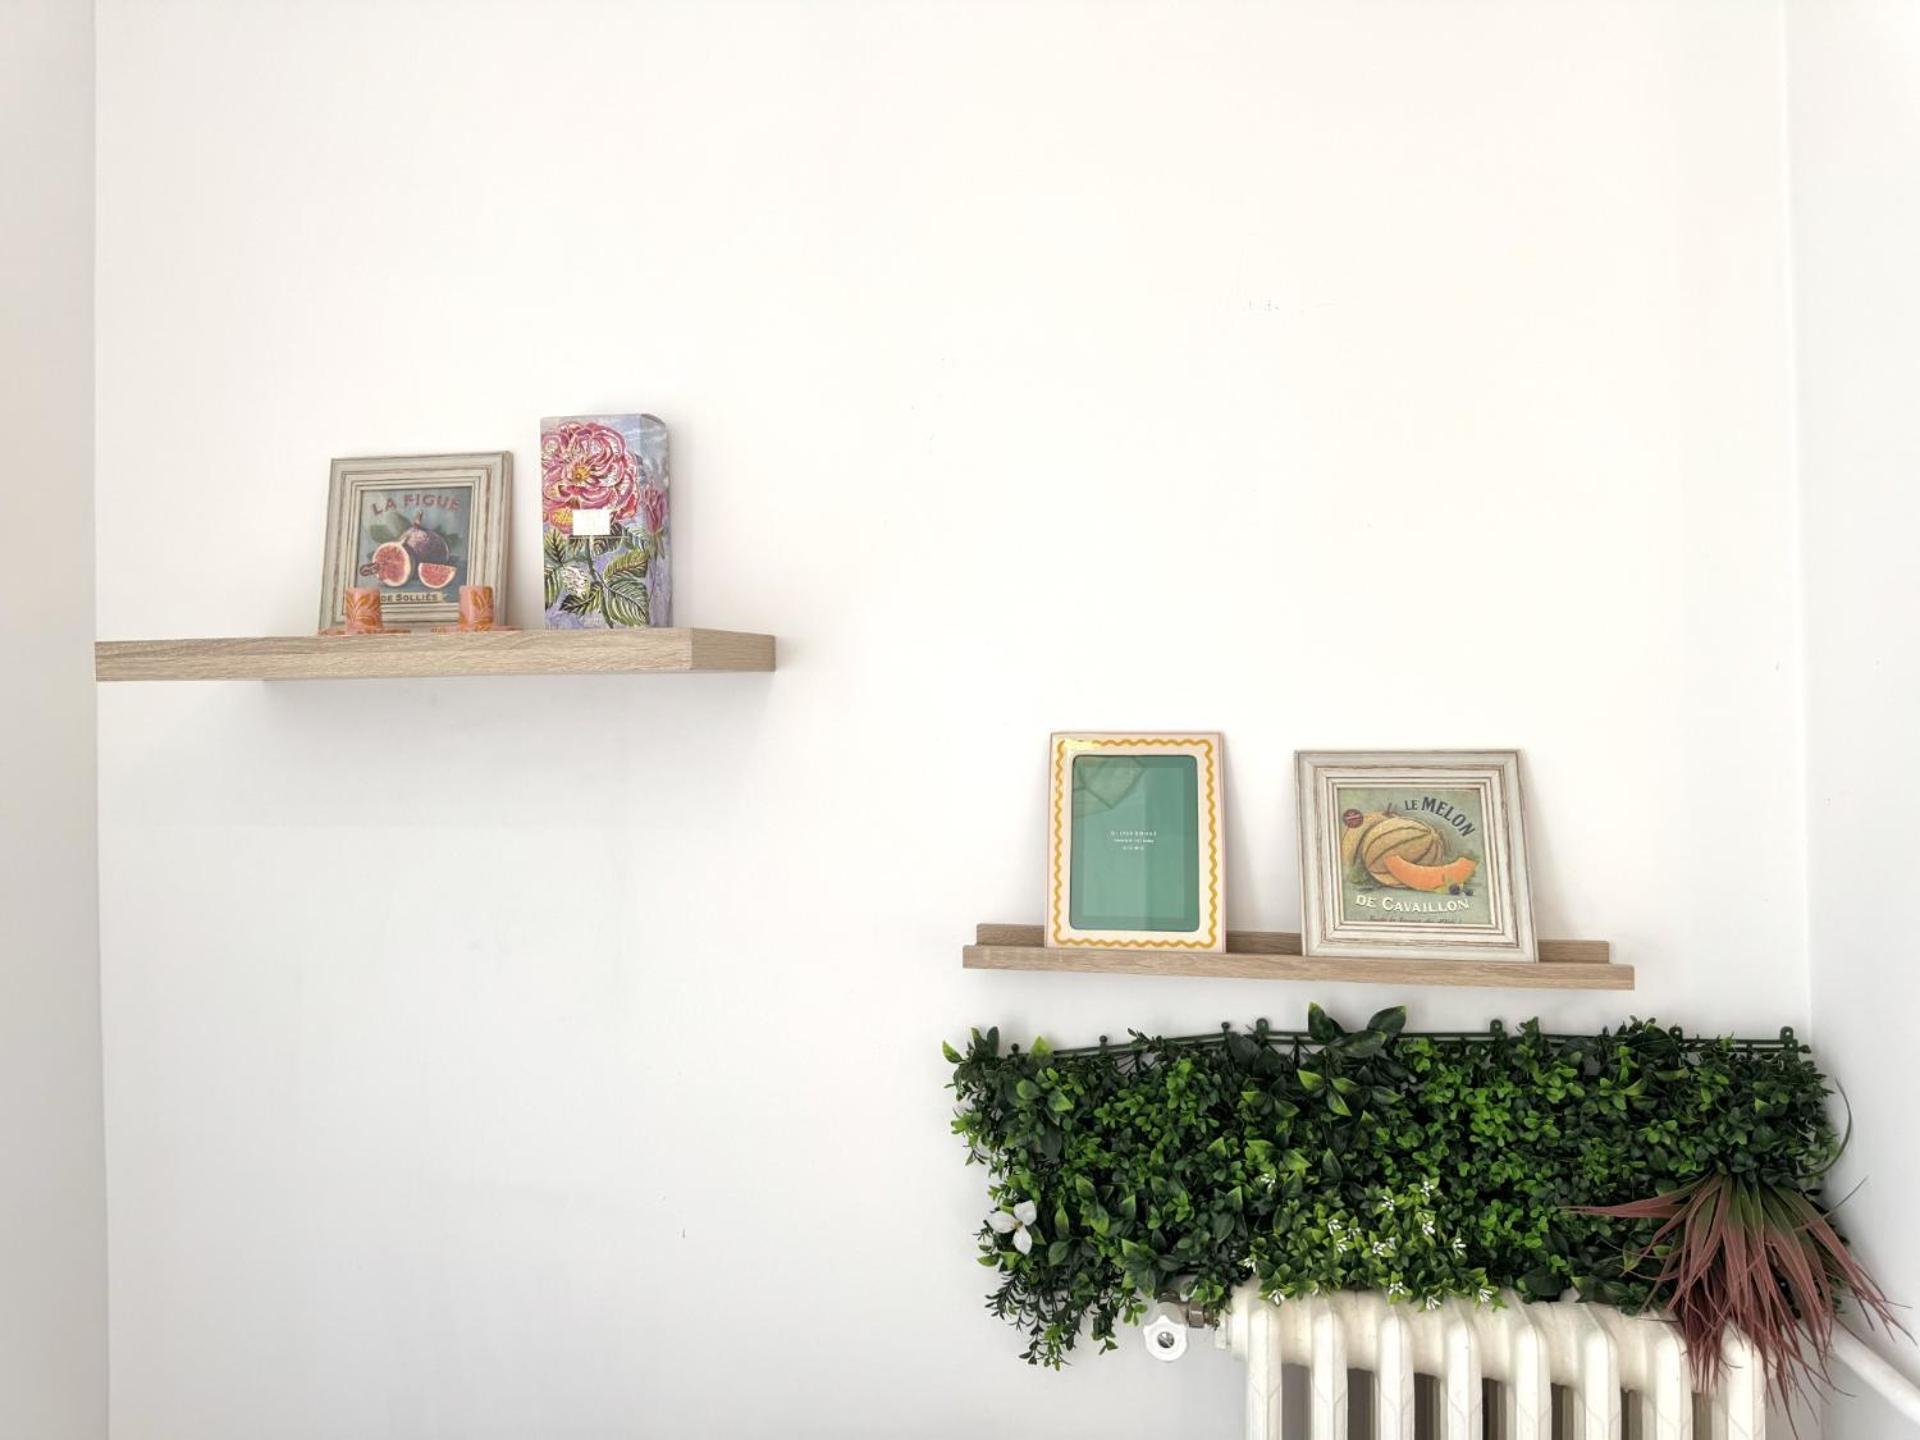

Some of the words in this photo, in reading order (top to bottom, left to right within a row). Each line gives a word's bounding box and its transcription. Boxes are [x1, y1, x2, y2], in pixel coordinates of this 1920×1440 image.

[372, 497, 398, 516] LA
[403, 493, 461, 513] FIGUE
[1404, 799, 1418, 811] LE
[1421, 796, 1476, 837] MELON
[1355, 894, 1377, 908] DE
[1381, 896, 1470, 913] CAVAILLON
